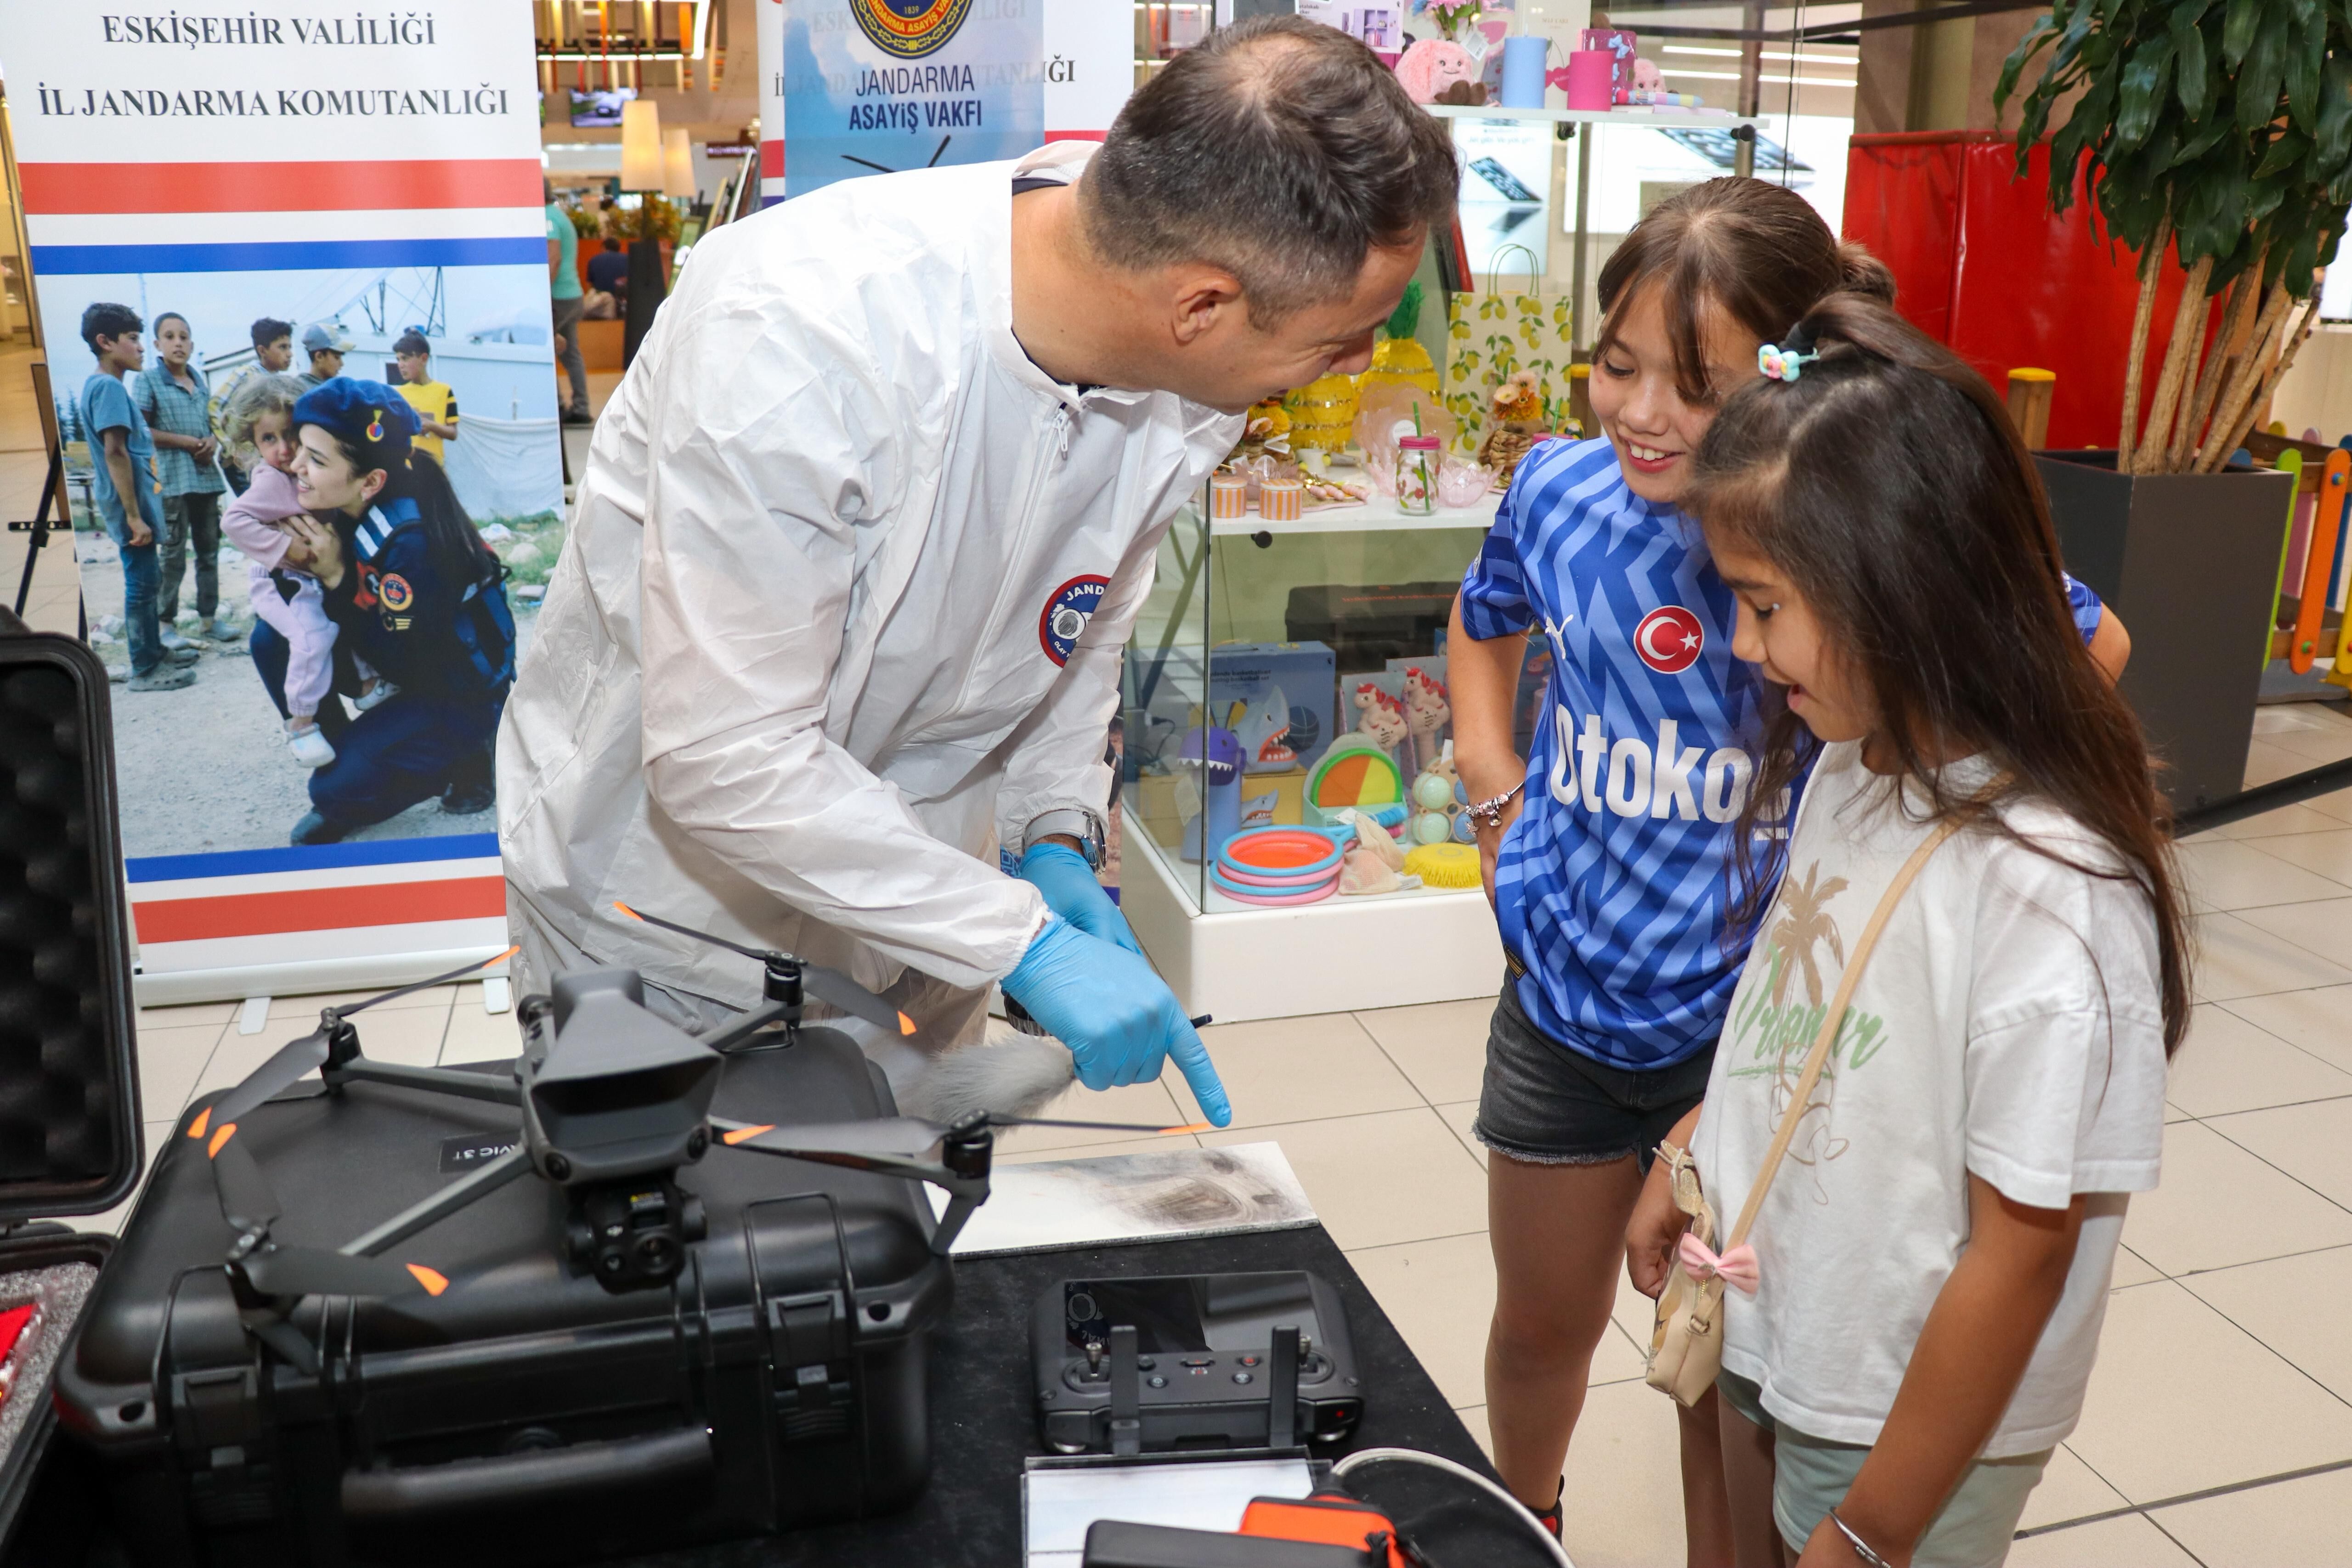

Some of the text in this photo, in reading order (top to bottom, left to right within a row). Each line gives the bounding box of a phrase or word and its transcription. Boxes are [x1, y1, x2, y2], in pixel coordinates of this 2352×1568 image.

[904, 6, 919, 14] 1839
[101, 10, 437, 50] ESKİŞEHİR VALİLİĞİ
[856, 64, 975, 96] JANDARMA
[37, 81, 509, 116] İL JANDARMA KOMUTANLIĞI
[925, 100, 982, 127] VAKFI
[1054, 641, 1066, 655] OLAY
[452, 1149, 475, 1161] 3T
